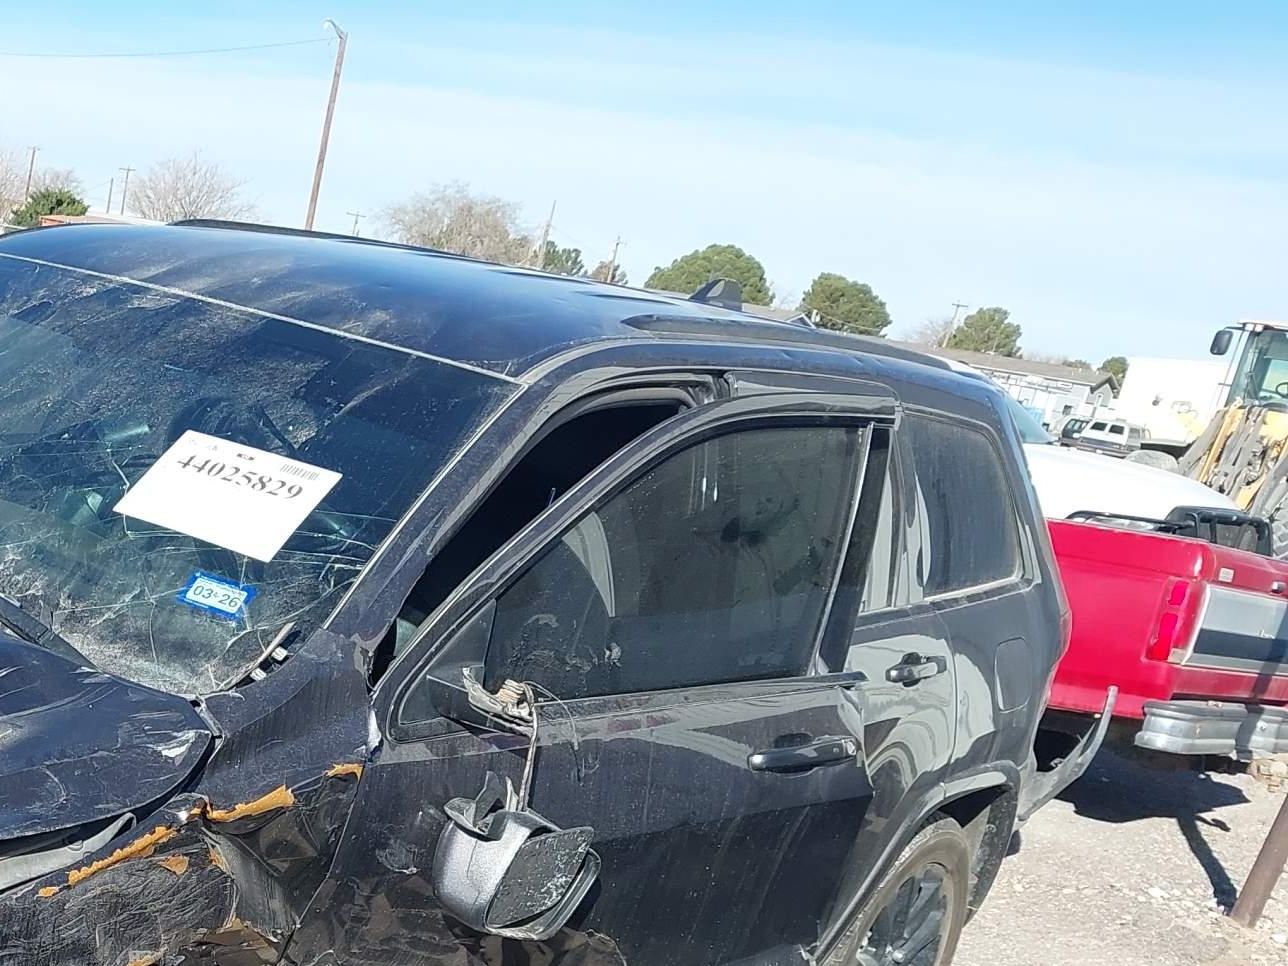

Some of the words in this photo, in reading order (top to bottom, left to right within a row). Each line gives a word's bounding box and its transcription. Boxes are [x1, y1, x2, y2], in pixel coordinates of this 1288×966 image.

[177, 454, 304, 500] 44025829
[193, 585, 214, 599] 03
[218, 593, 241, 608] 26
